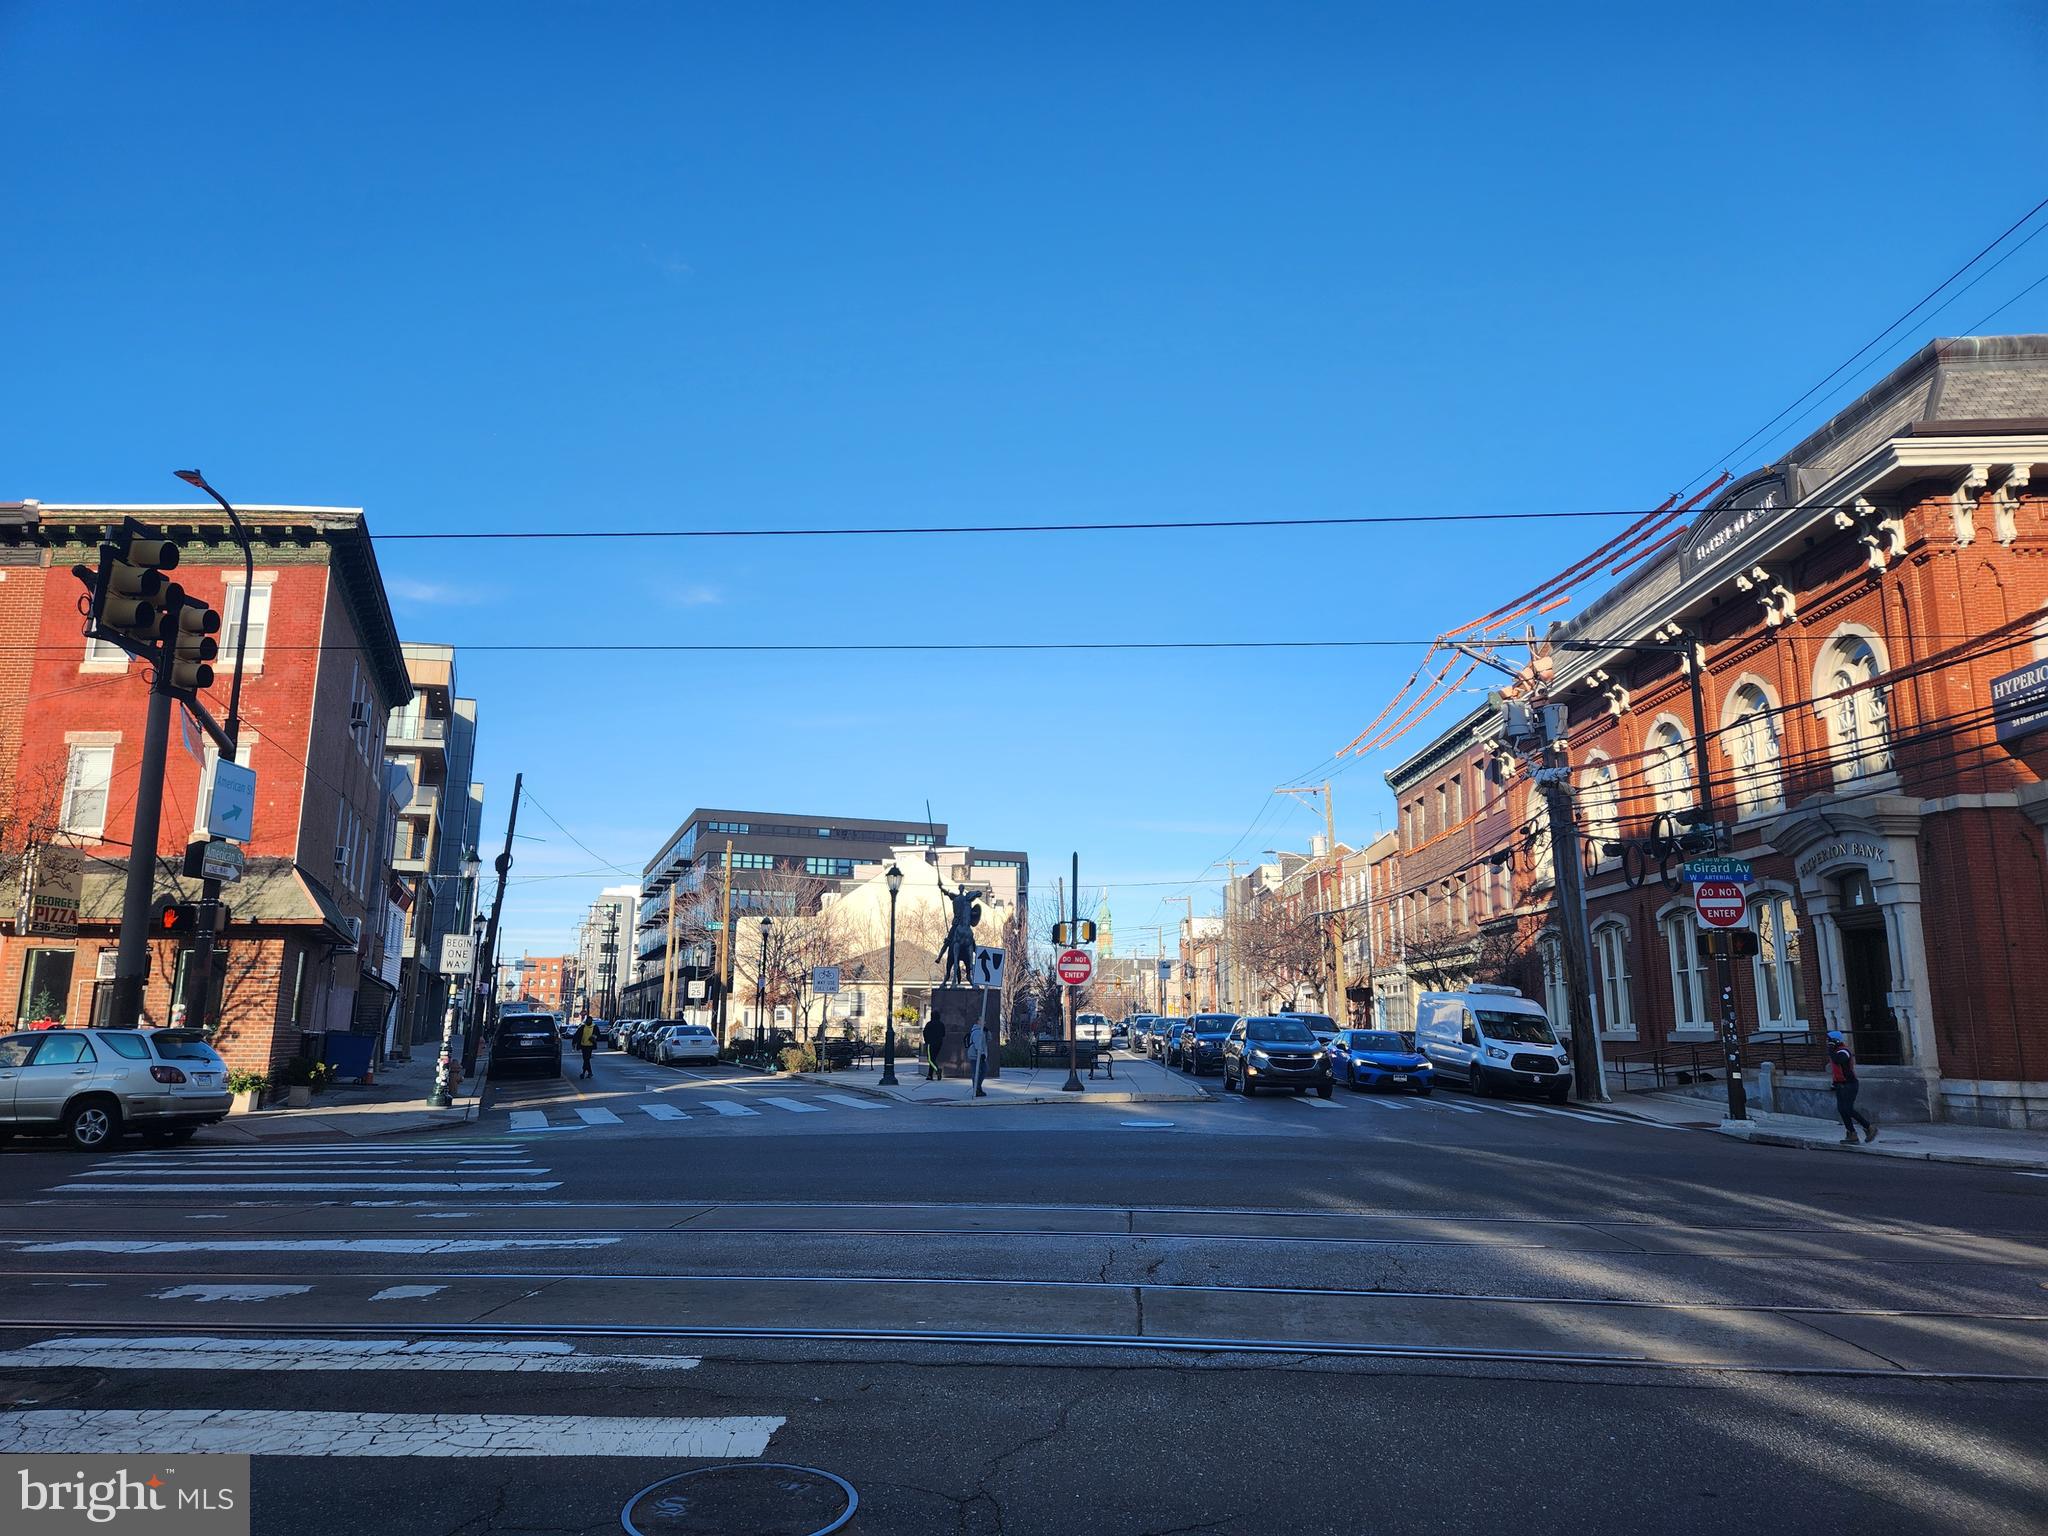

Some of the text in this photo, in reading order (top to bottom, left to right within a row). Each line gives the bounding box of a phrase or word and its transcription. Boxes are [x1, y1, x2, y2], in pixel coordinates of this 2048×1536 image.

[217, 775, 246, 793] American
[205, 847, 235, 862] American
[1851, 842, 1884, 862] BANK
[1693, 863, 1750, 873] Girard Av
[1701, 888, 1737, 896] DO NOT
[35, 895, 80, 908] GEORGE'S
[34, 906, 78, 924] PIZZA
[1707, 909, 1737, 918] ENTER
[446, 939, 472, 948] BEGIN
[447, 949, 469, 959] ONE
[446, 960, 468, 969] WAY
